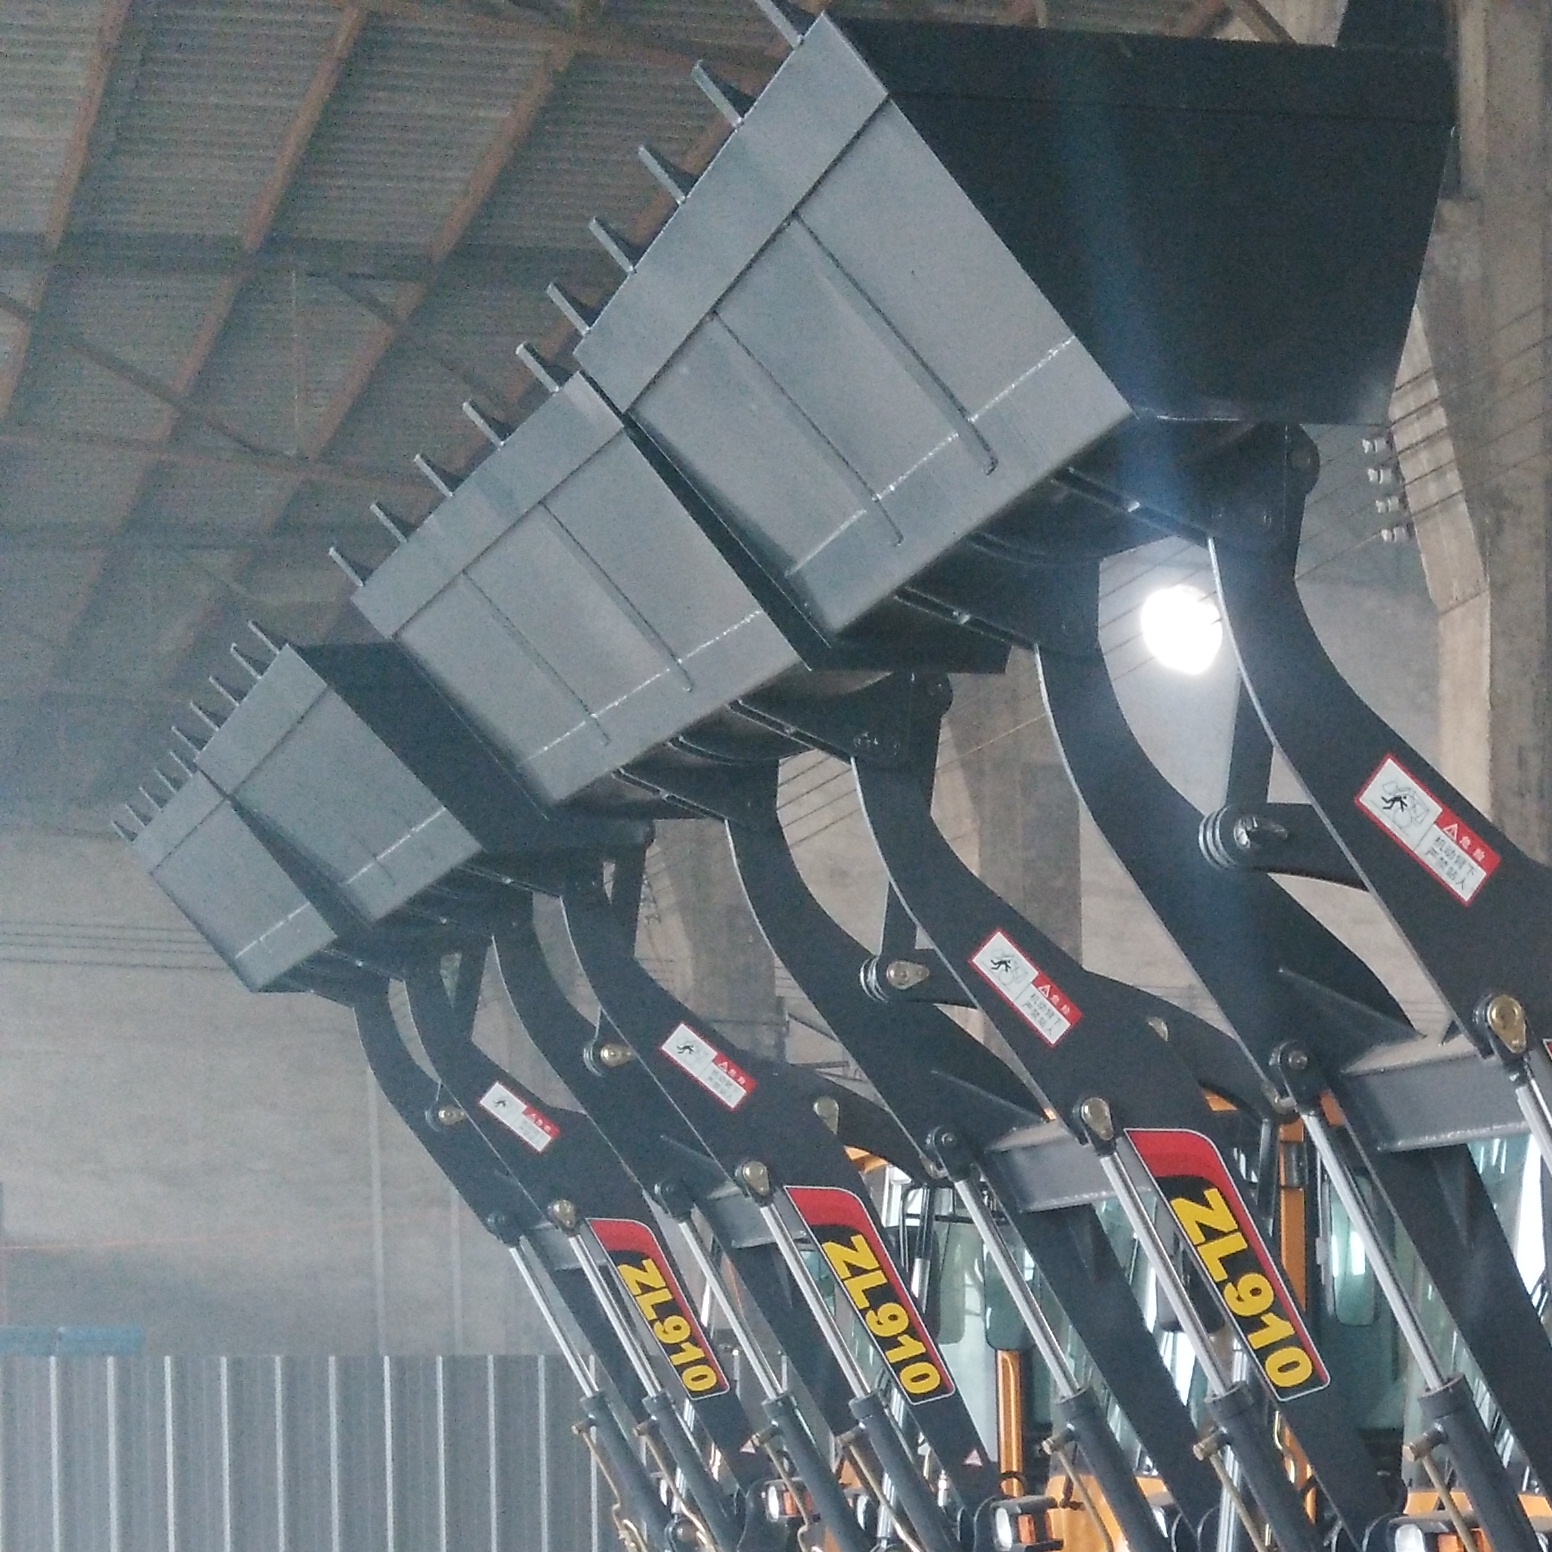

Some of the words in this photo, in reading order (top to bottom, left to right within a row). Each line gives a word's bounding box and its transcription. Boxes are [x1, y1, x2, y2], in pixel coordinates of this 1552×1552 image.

[617, 1259, 717, 1391] ZL910
[821, 1234, 941, 1394] ZL910
[1170, 1188, 1313, 1387] ZL910
